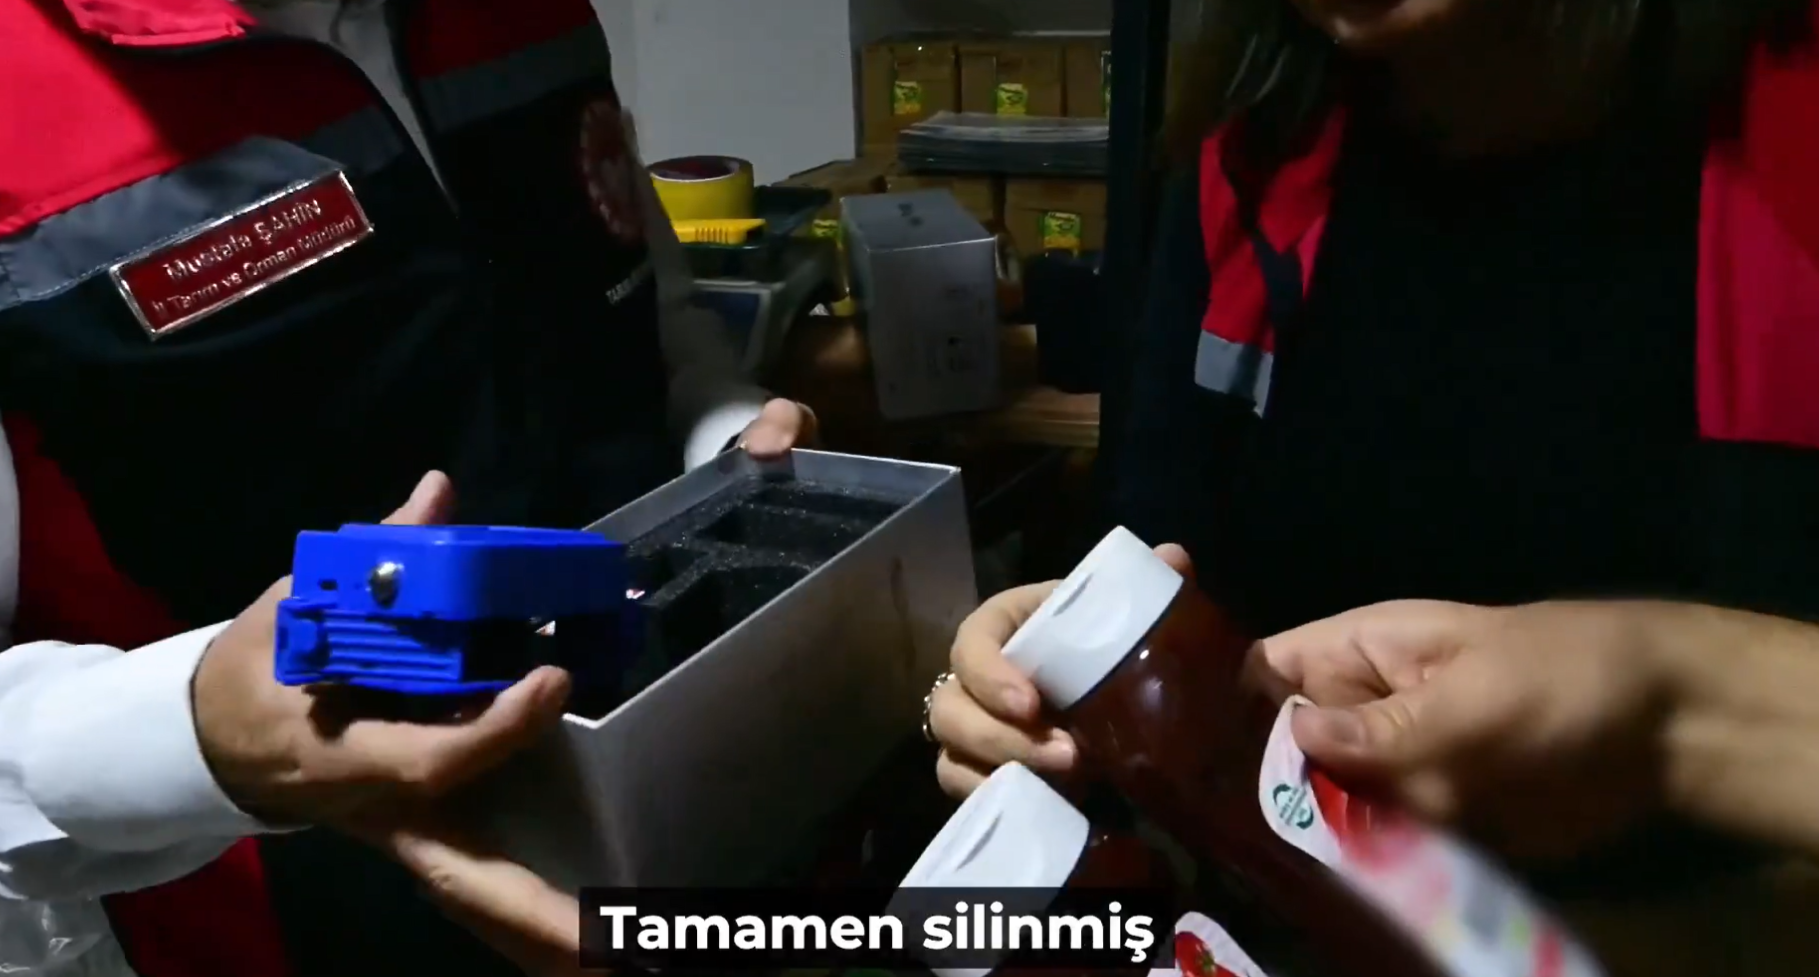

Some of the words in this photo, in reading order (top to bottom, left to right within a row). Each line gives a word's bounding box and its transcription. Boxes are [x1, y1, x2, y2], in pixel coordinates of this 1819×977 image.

[162, 235, 252, 280] Mustafa
[254, 199, 322, 245] ŞAHİN
[221, 271, 243, 288] ve
[243, 245, 297, 276] Orman
